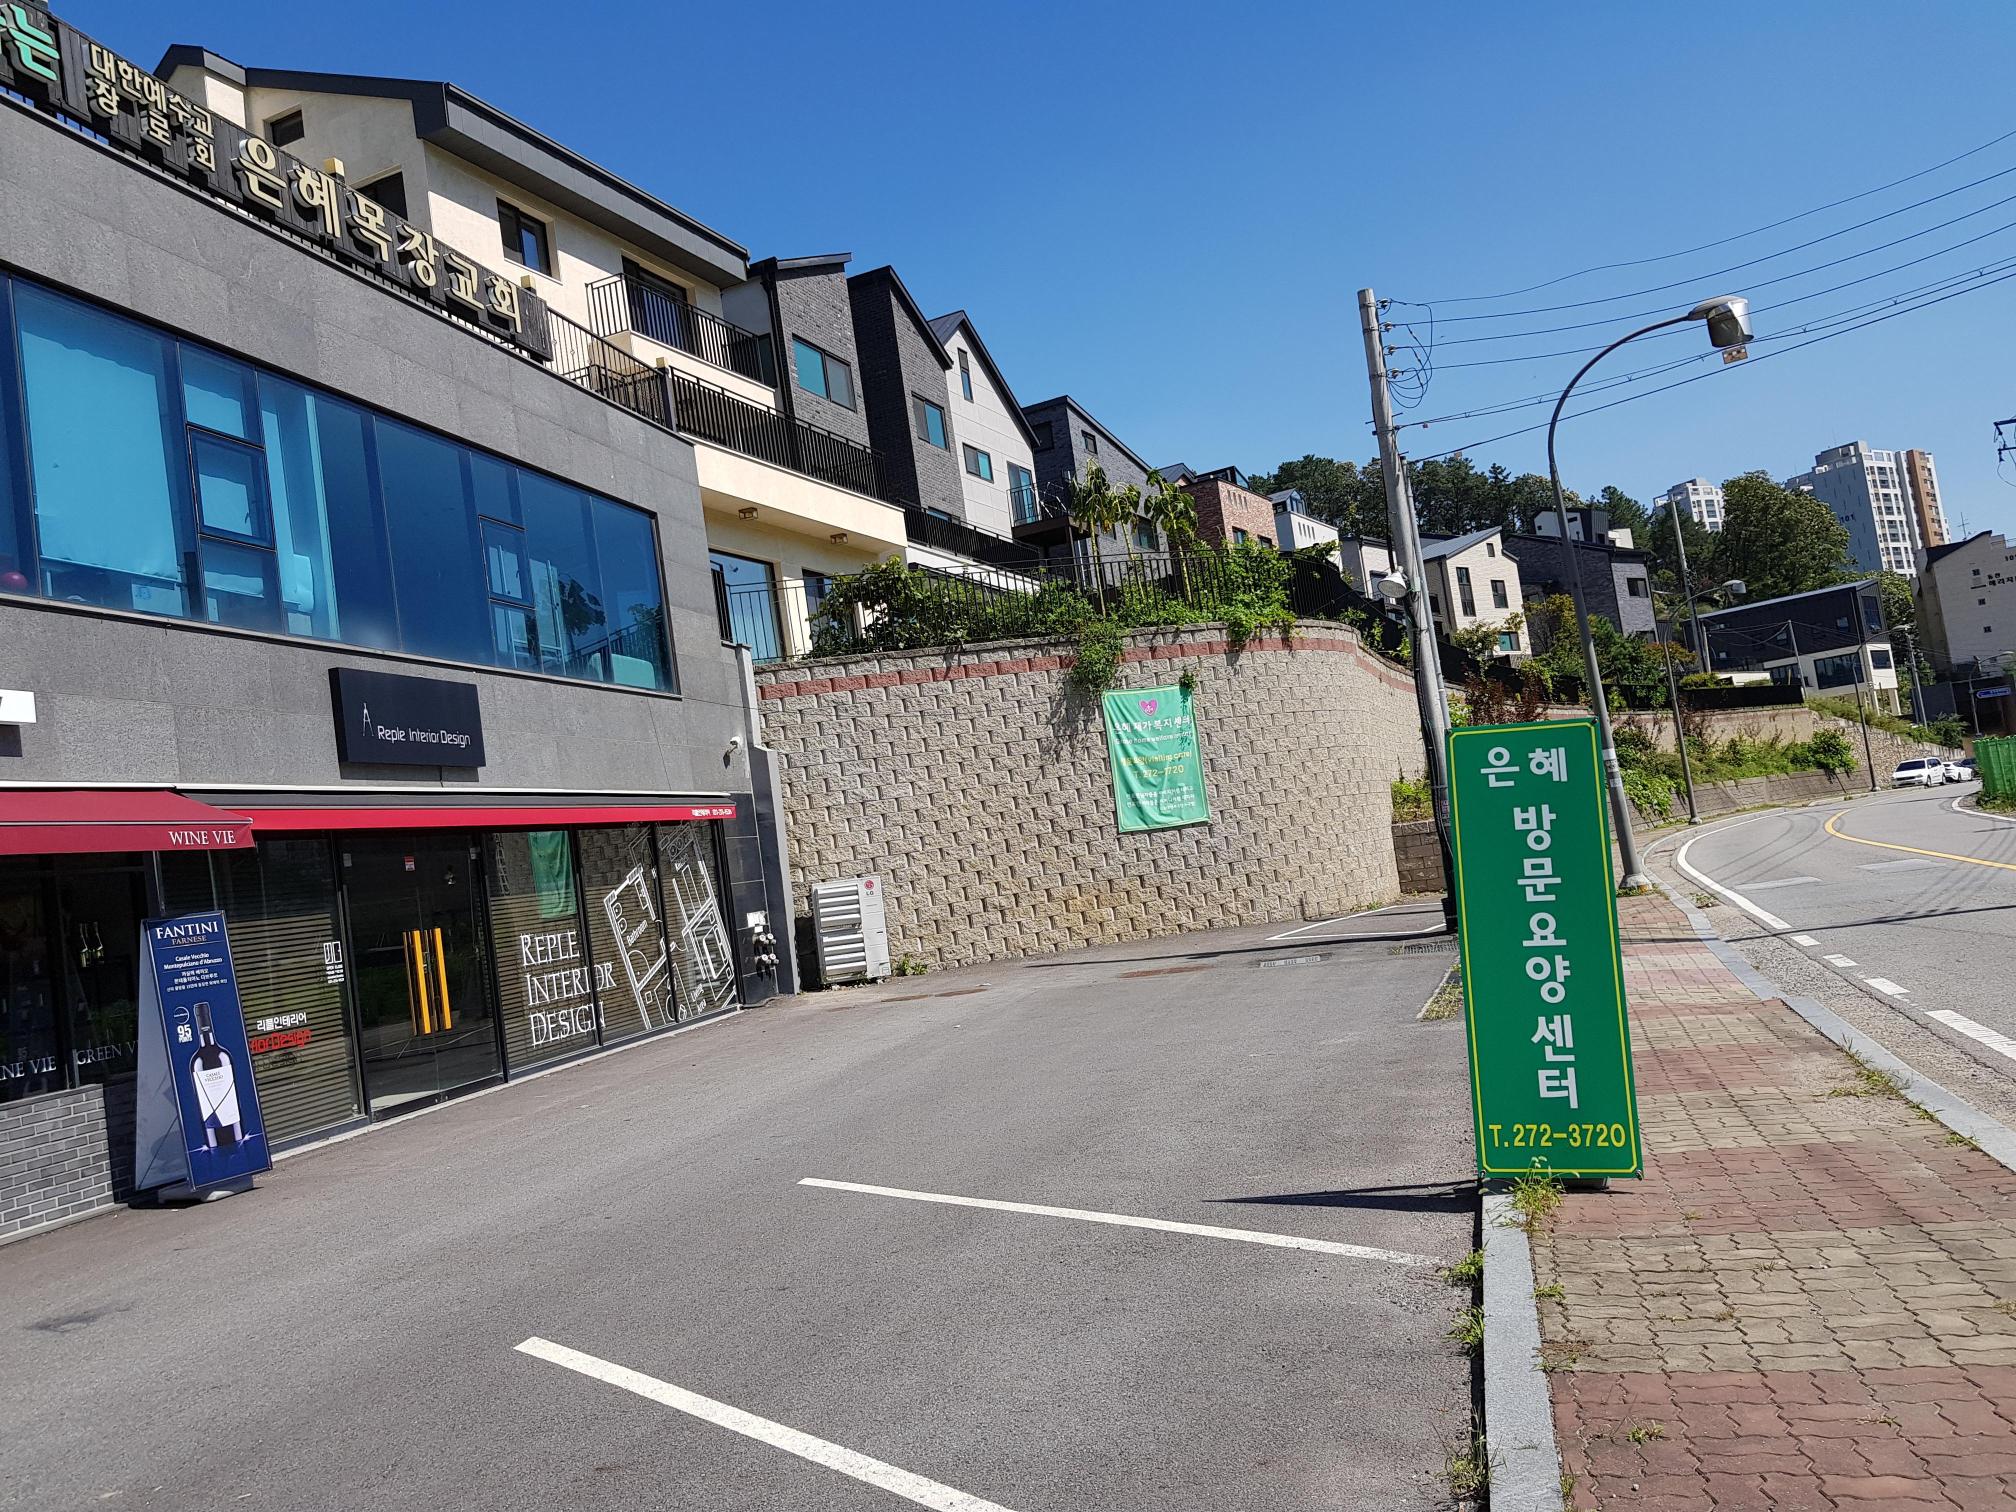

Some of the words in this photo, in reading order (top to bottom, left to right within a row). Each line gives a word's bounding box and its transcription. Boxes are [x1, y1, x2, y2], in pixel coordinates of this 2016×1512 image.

[0, 3, 60, 81] 는
[90, 43, 214, 138] 대한예수교
[238, 137, 522, 333] 은혜목장교회
[2004, 554, 2016, 562] 10
[377, 725, 406, 744] Reple
[408, 727, 440, 743] Interior
[440, 730, 471, 748] Design
[1480, 747, 1568, 788] 은혜
[168, 830, 209, 845] WINE
[212, 830, 236, 844] VIE
[155, 921, 219, 939] FANTINI
[172, 934, 207, 945] FARNESE
[1513, 804, 1578, 1109] 방문요양센터
[177, 1023, 192, 1038] 95
[28, 1056, 57, 1074] VIE
[76, 1043, 122, 1065] GREEN
[1488, 1123, 1626, 1148] T.272-3720
